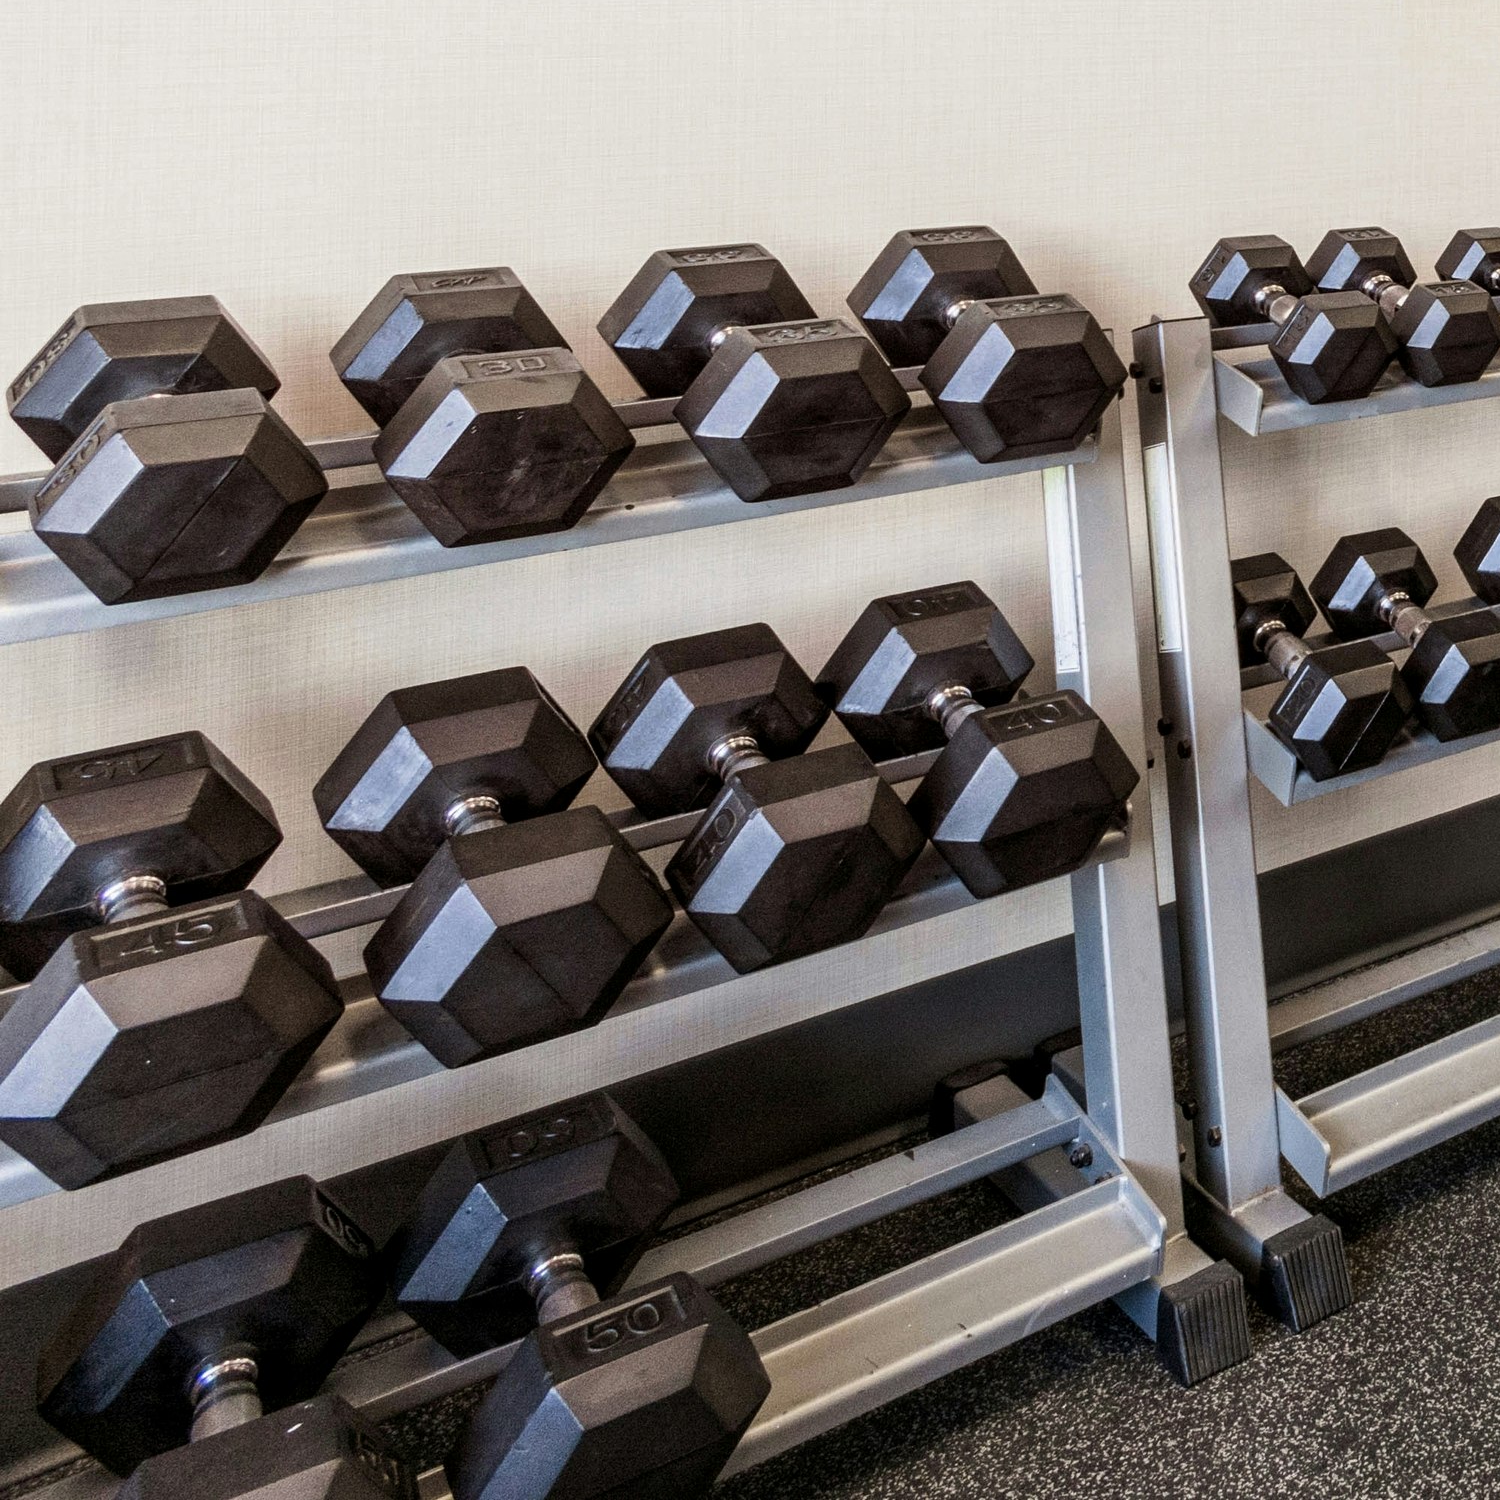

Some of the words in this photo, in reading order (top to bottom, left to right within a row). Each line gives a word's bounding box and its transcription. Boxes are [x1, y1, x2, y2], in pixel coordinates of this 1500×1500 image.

[478, 356, 547, 376] 30
[1006, 703, 1064, 730] 40
[119, 914, 214, 955] 45
[584, 1303, 663, 1352] 50
